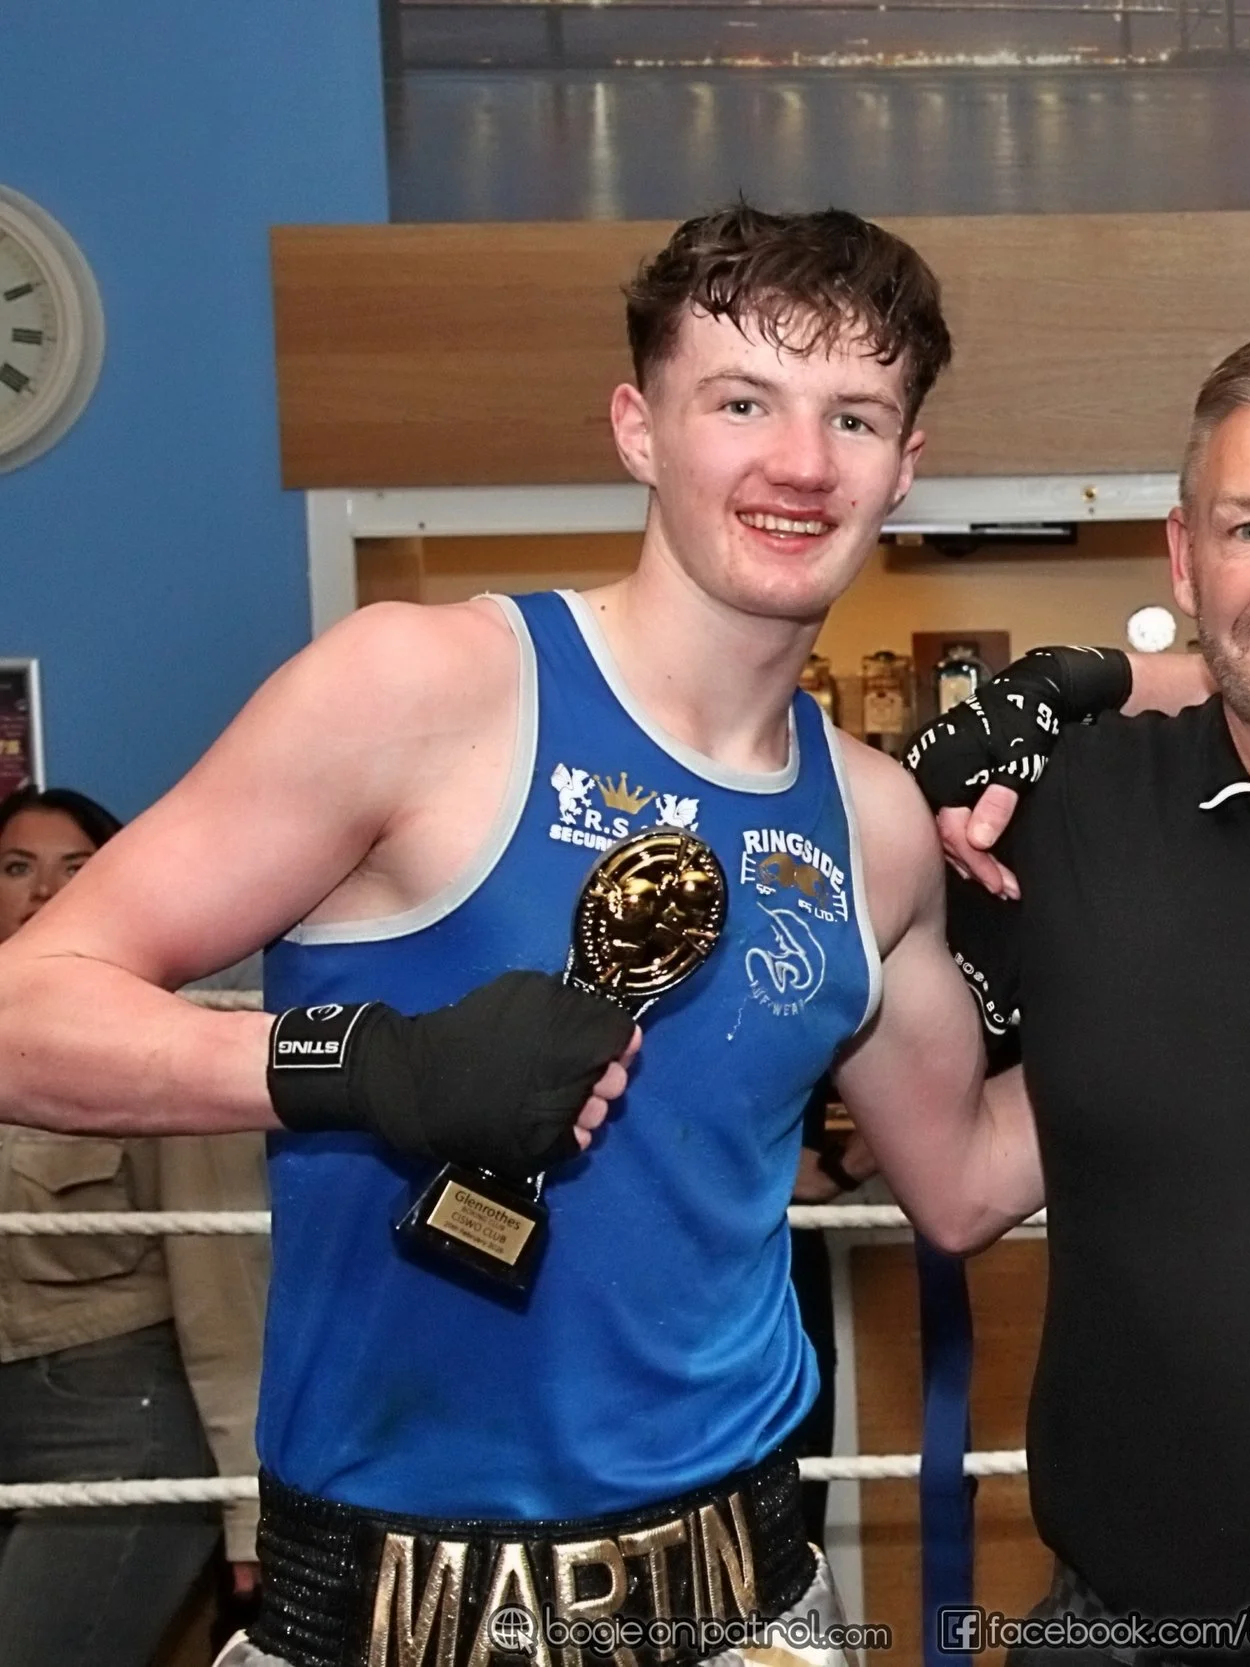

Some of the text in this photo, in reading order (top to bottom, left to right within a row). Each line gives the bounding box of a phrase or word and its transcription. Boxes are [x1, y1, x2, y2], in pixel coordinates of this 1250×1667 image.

[549, 824, 616, 851] SECURI
[742, 829, 844, 893] RINGSIDE
[278, 1041, 340, 1054] STING
[451, 1211, 507, 1244] CISWO CLUB
[455, 1190, 521, 1230] Glenrothes
[367, 1492, 757, 1667] MARTIN
